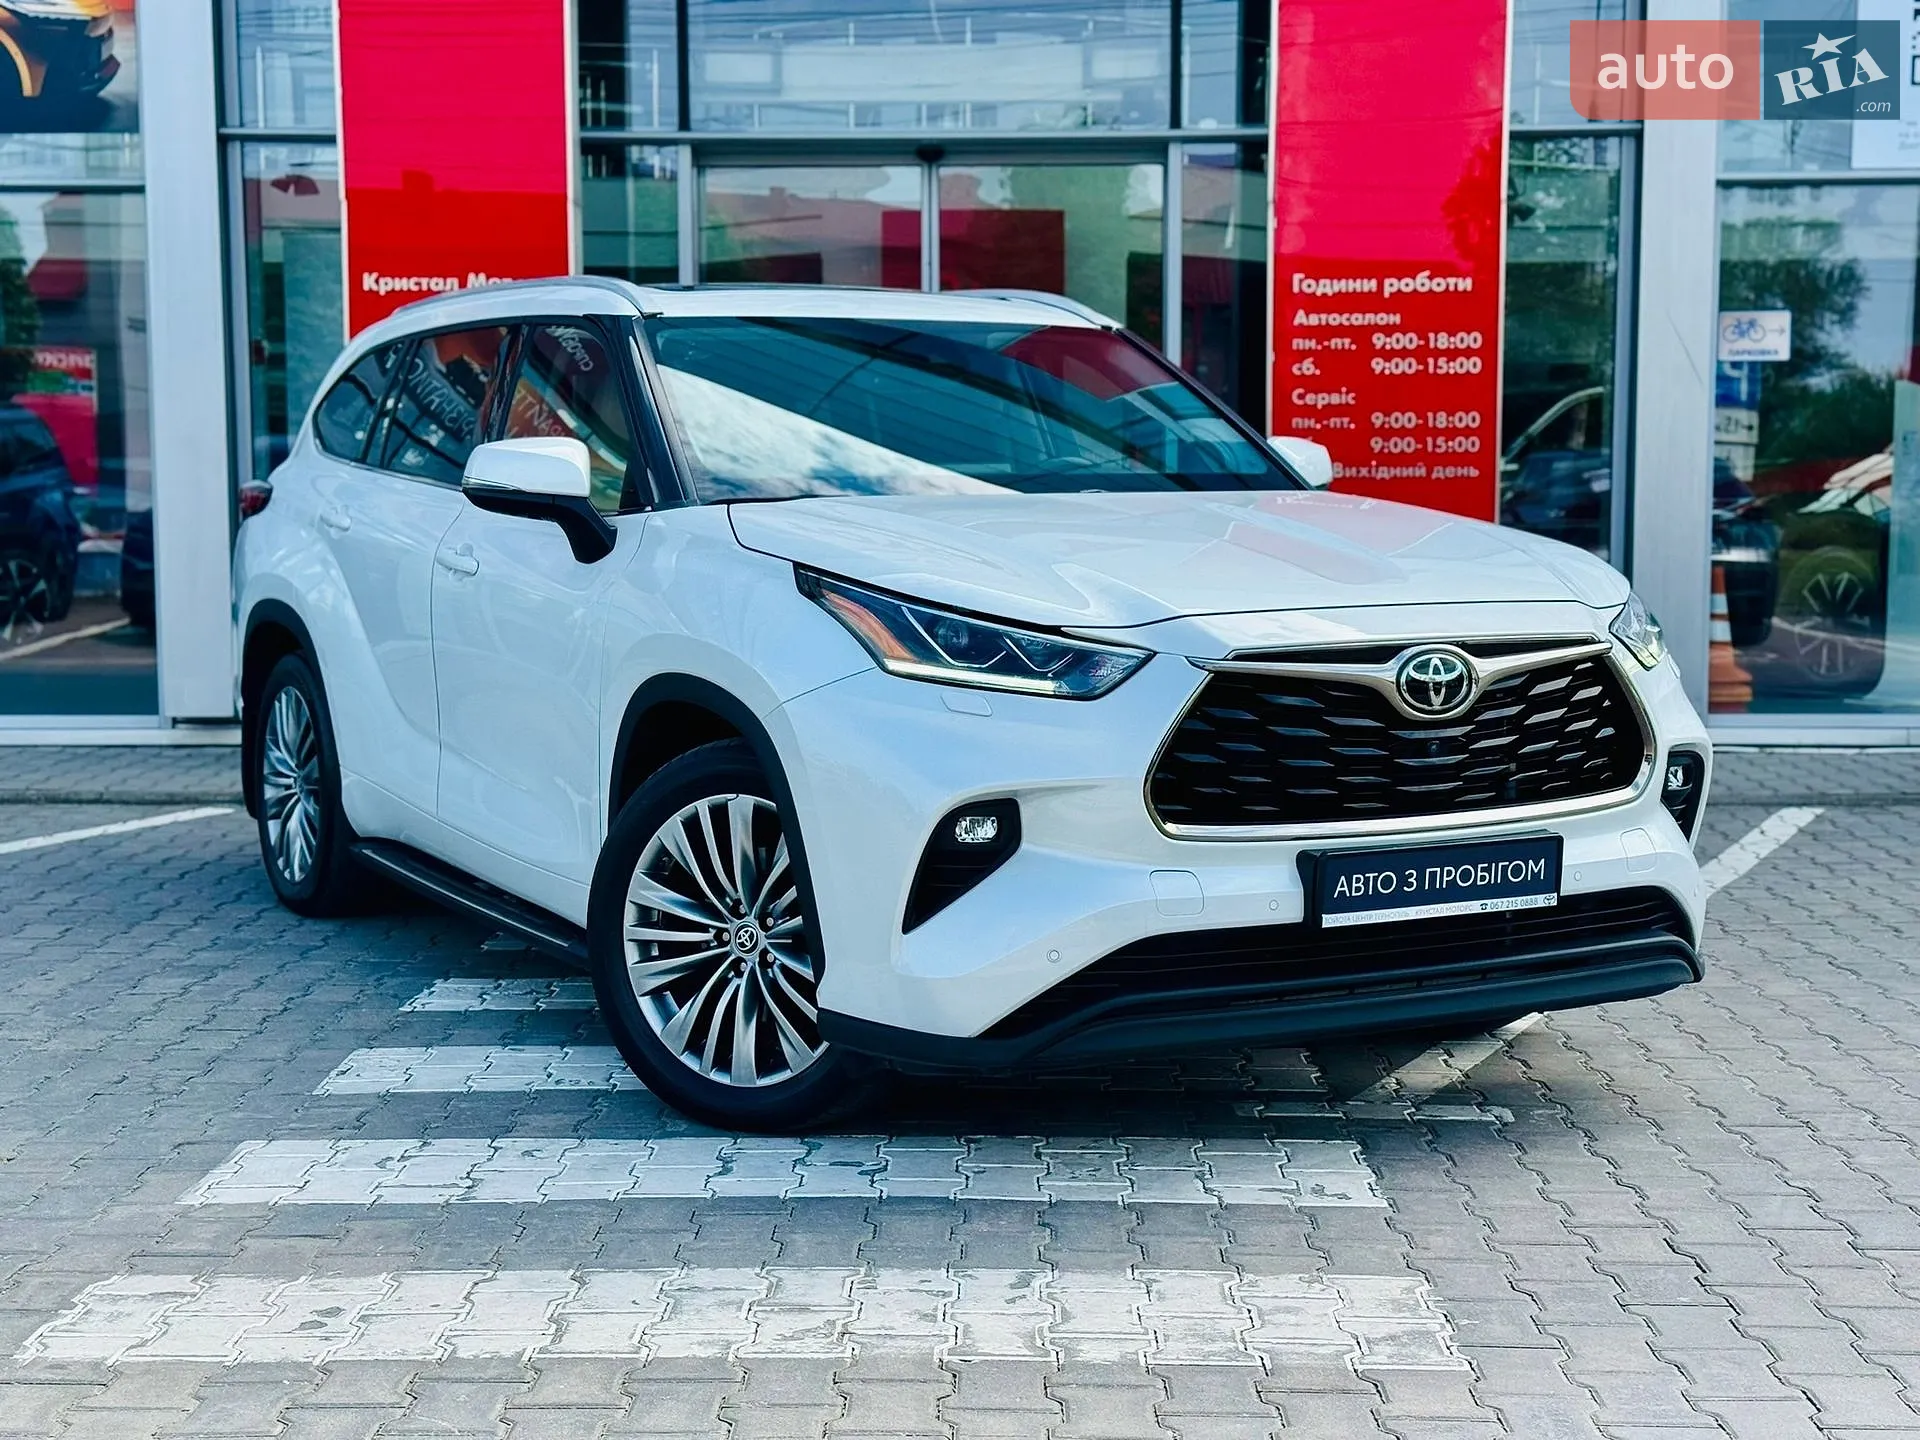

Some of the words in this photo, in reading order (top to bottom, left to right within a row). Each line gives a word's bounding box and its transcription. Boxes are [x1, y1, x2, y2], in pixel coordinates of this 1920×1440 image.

[362, 272, 459, 296] Кристал
[1291, 273, 1378, 297] Години
[1383, 270, 1473, 298] роботи
[1293, 309, 1401, 326] Автосалон
[1291, 336, 1357, 350] пн.-пт.
[1371, 331, 1483, 350] 9:00-18:00
[1291, 356, 1321, 375] сб.
[1371, 356, 1482, 375] 9:00-15:00
[1291, 387, 1356, 410] Сервіс
[1291, 416, 1356, 429] пн.-пт.
[1370, 411, 1481, 429] 9:00-18:00
[1370, 436, 1480, 453] 9:00-15:00
[1333, 460, 1426, 480] Вихідний
[1431, 463, 1480, 480] день
[1333, 871, 1397, 898] АВТО
[1403, 869, 1417, 892] З
[1424, 858, 1545, 890] ПРОБІГОМ
[1506, 900, 1519, 908] 215
